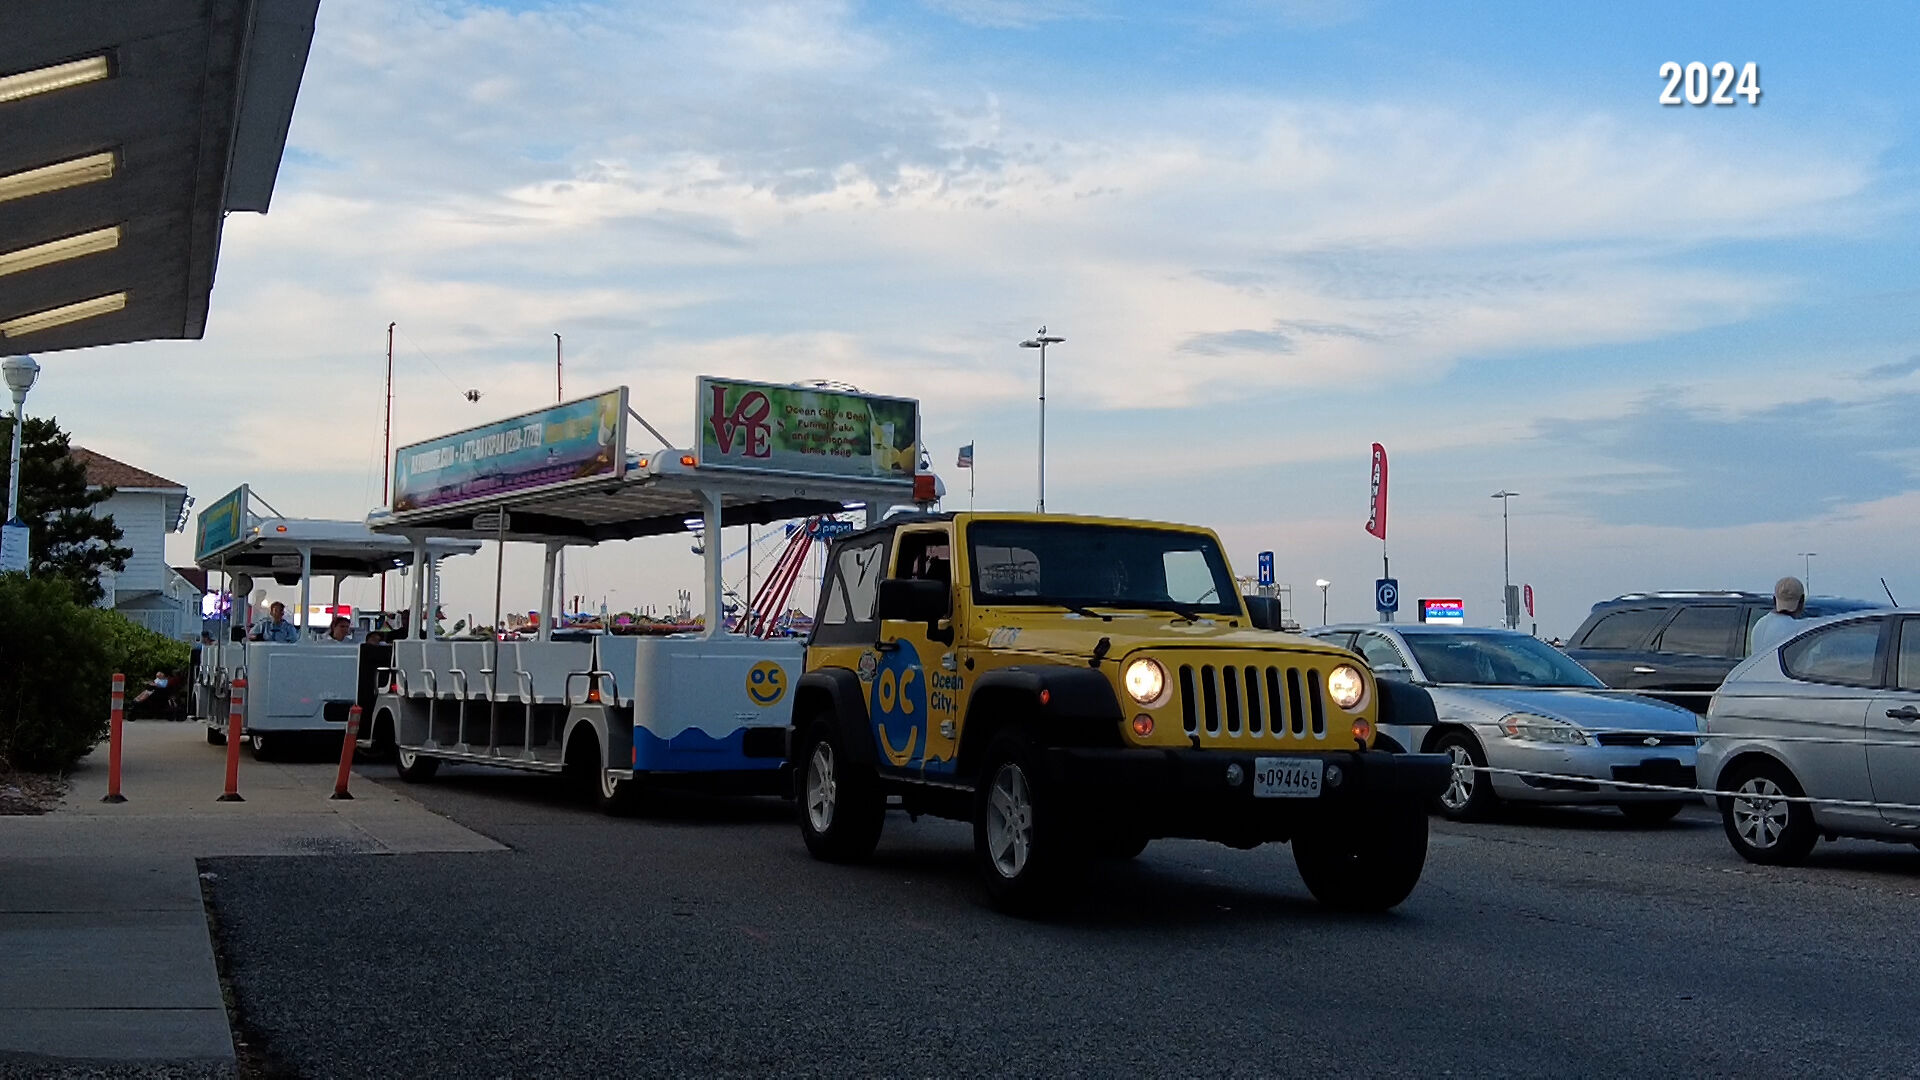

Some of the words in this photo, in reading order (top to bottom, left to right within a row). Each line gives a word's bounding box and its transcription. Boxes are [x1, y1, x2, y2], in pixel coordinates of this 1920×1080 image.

[785, 405, 816, 416] Ocean
[710, 385, 771, 458] LOVE
[822, 523, 851, 534] pepsi
[1261, 564, 1270, 582] H
[751, 669, 779, 684] OC
[932, 671, 964, 690] Ocean
[878, 667, 915, 714] OC
[931, 691, 952, 715] City
[1267, 769, 1309, 788] 09446
